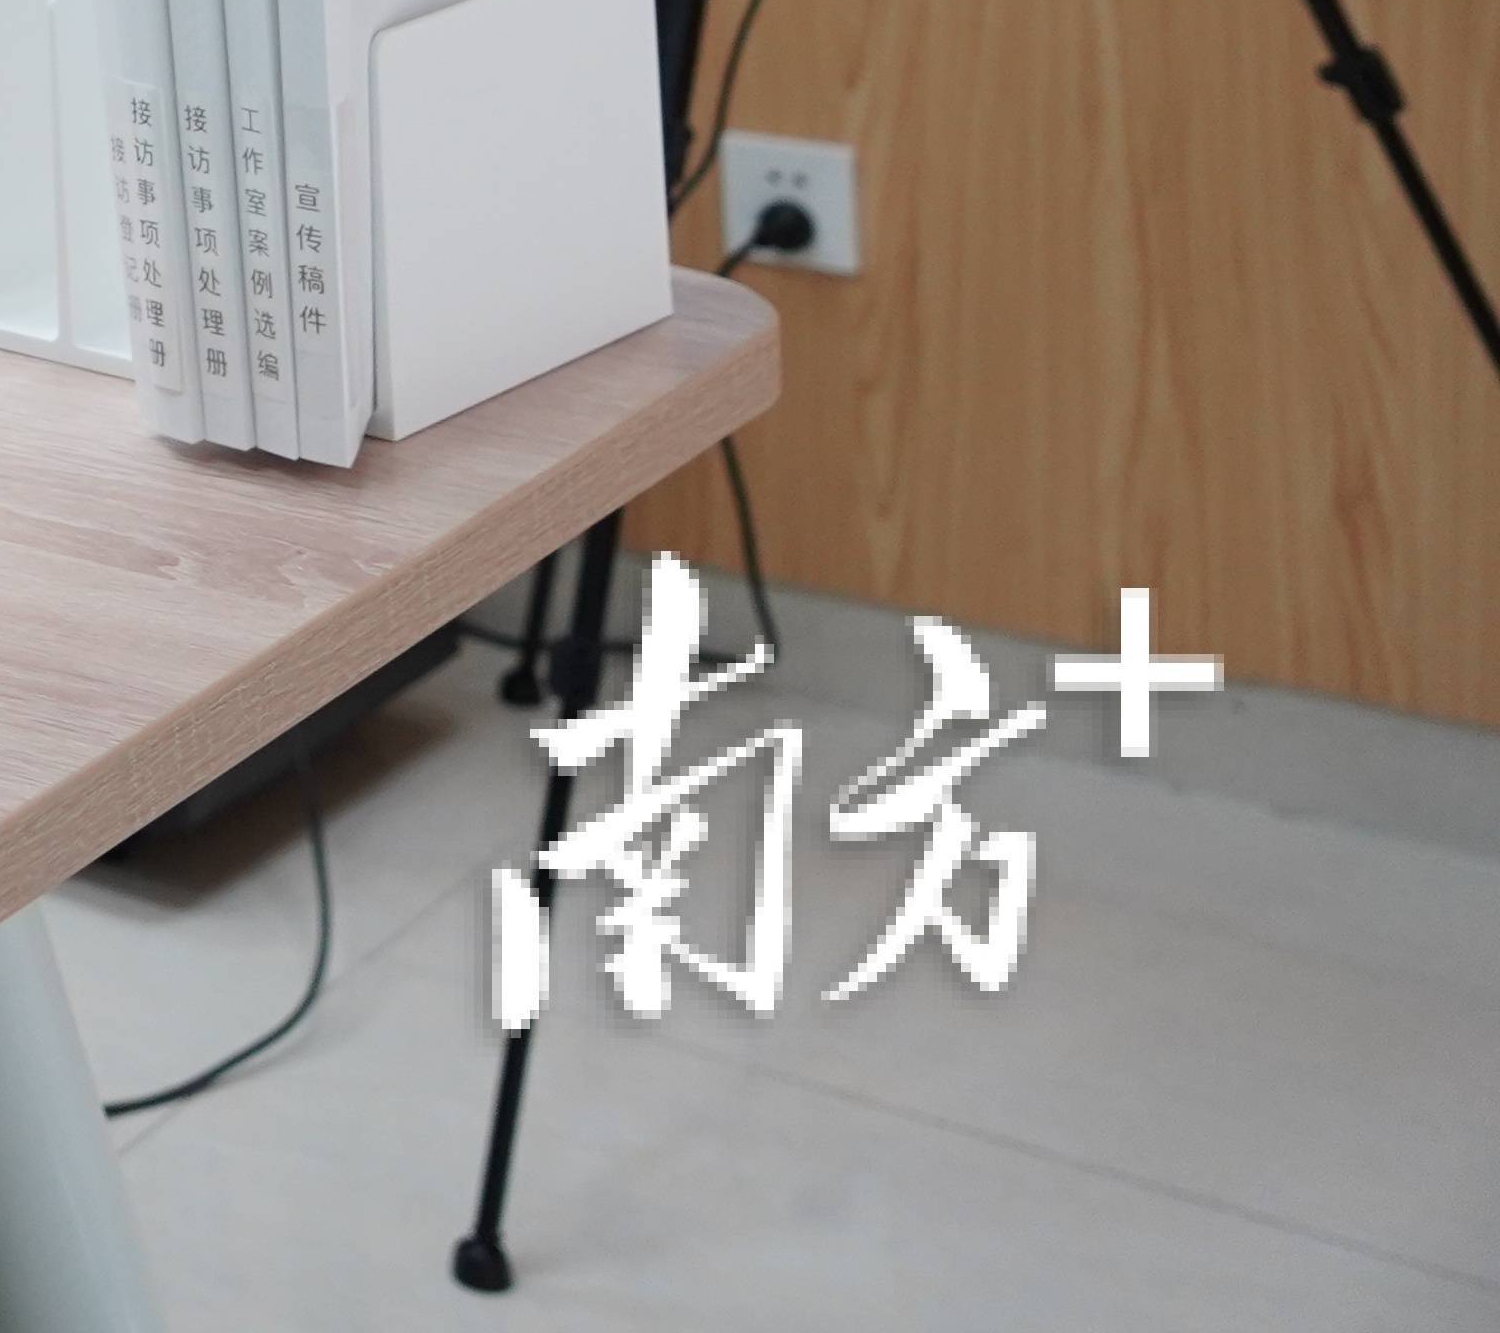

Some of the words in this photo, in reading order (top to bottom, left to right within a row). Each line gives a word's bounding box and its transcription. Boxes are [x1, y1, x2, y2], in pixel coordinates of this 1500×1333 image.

[131, 96, 166, 367] 接访事项处理册
[184, 104, 227, 378] 接访事项处理册
[241, 107, 279, 381] 工作室案例选编
[295, 183, 326, 334] 宣传稿件
